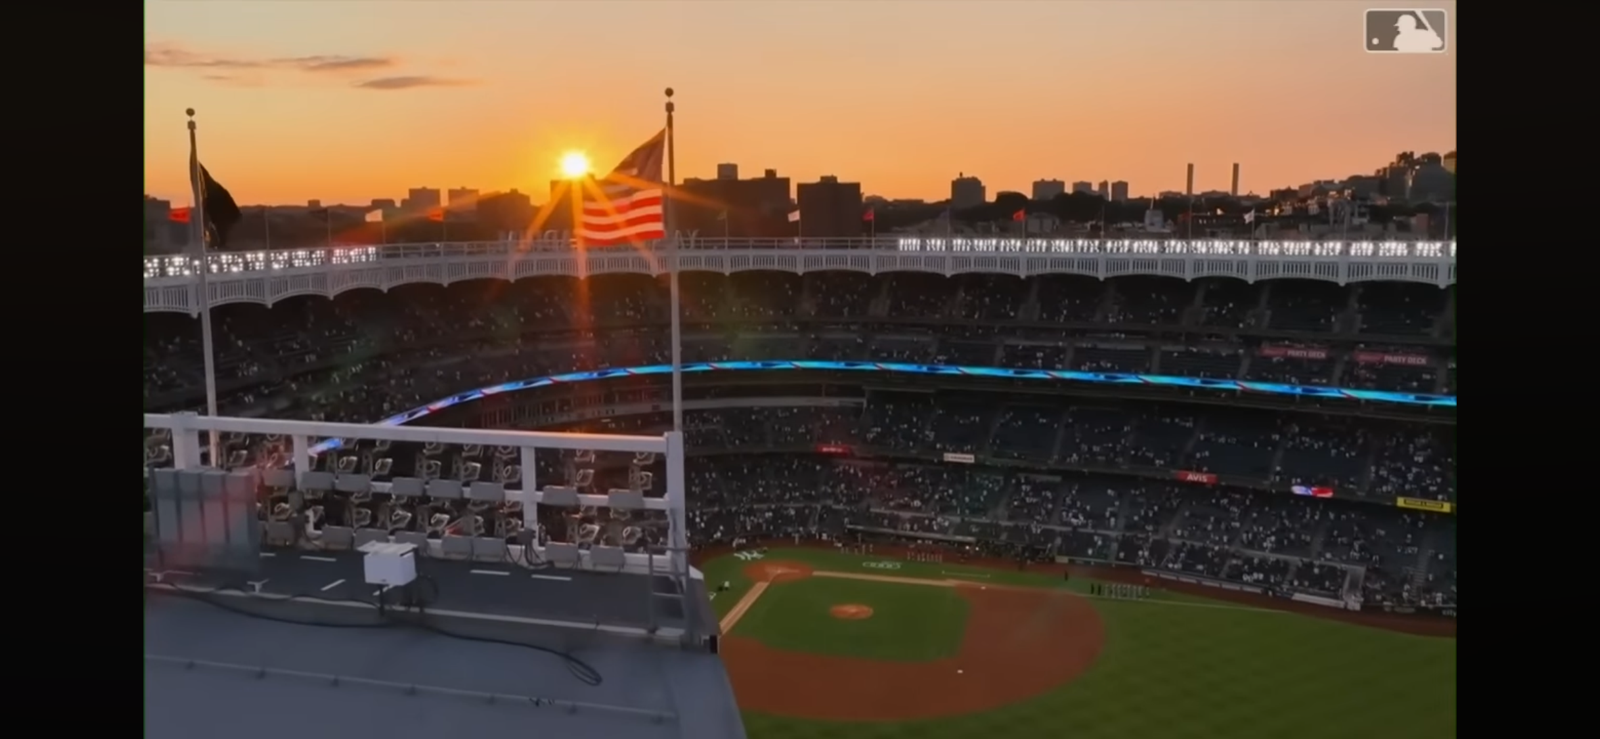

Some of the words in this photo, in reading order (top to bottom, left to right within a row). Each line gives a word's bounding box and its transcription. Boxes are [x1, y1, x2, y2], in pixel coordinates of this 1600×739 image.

[1287, 349, 1307, 358] PARTY
[1308, 350, 1327, 359] DECK
[1384, 355, 1406, 364] PARTY
[1407, 356, 1427, 365] DECK
[1186, 472, 1208, 483] AVIS
